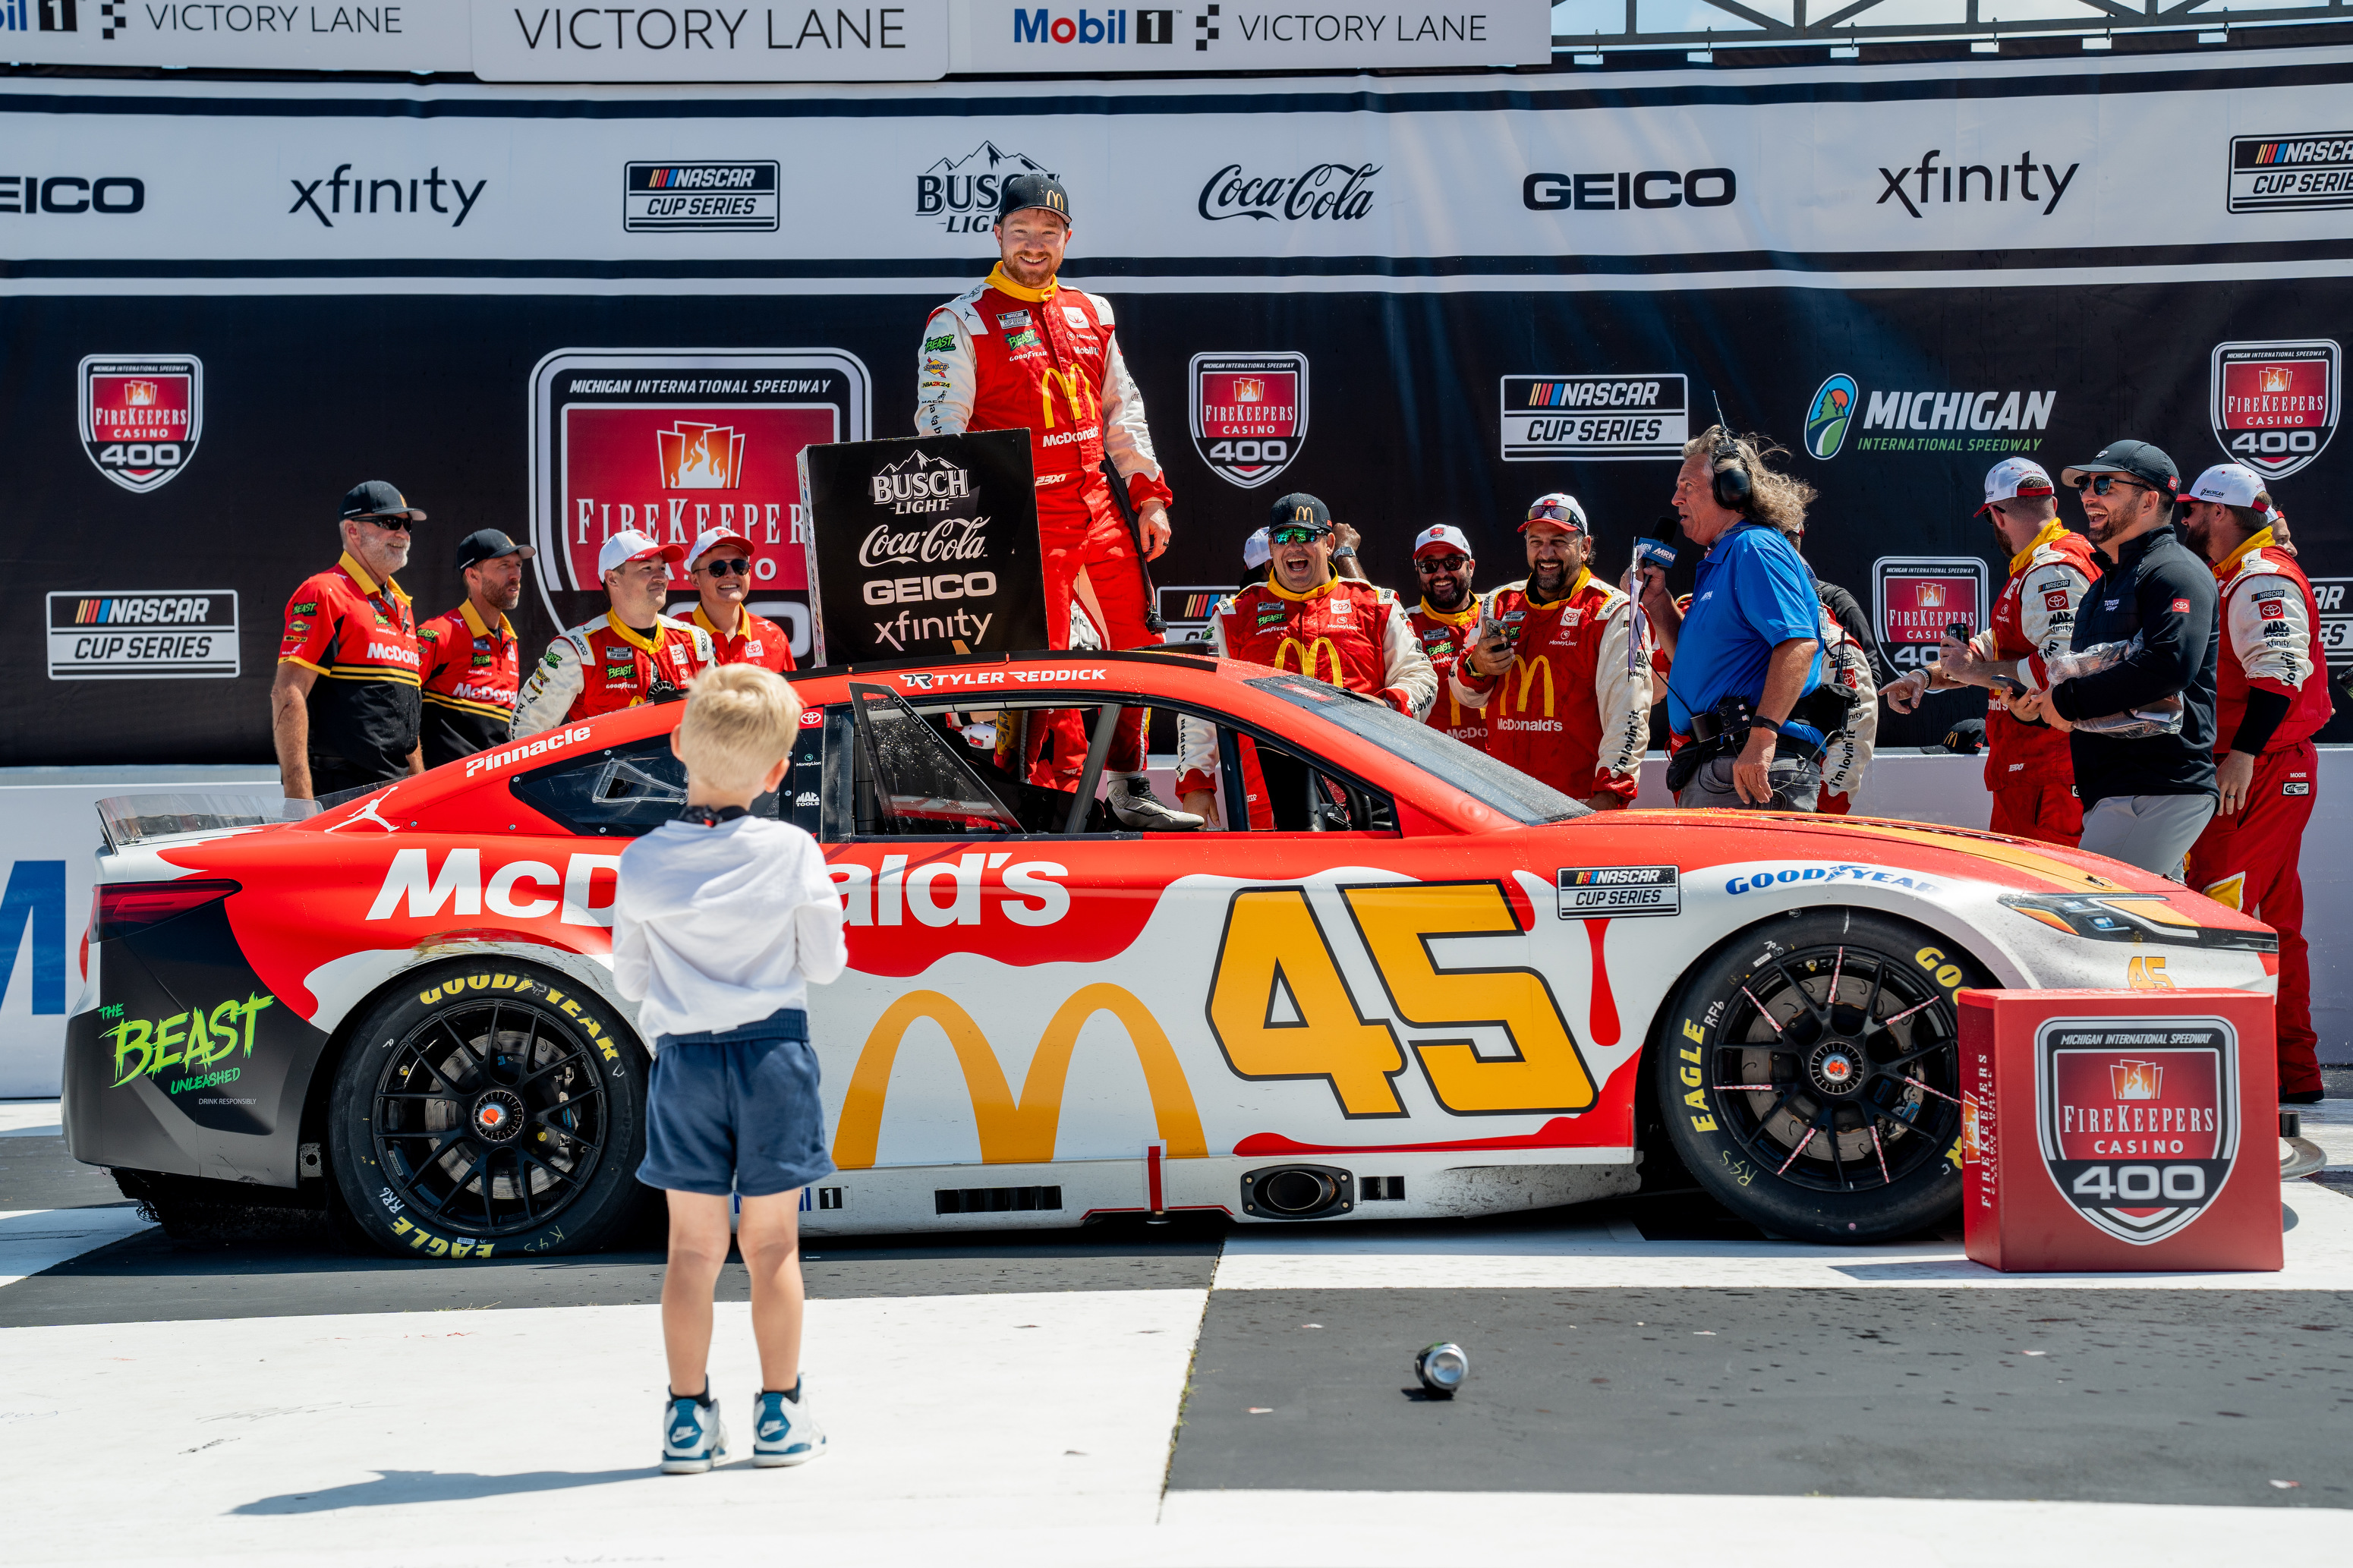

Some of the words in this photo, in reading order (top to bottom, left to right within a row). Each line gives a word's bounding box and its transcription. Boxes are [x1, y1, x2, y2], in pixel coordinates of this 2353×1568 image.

[146, 5, 298, 32] VICTORY
[311, 7, 402, 33] LANE
[514, 8, 748, 49] VICTORY
[767, 8, 906, 49] LANE
[1014, 8, 1126, 43] Mobil
[1239, 15, 1386, 41] VICTORY
[1397, 15, 1486, 41] LANE
[2284, 140, 2353, 162] NASCA
[675, 168, 756, 187] NASCAR
[1876, 150, 2080, 218] xfinity
[2253, 175, 2295, 194] CUP
[2298, 172, 2353, 193] SERIE
[0, 176, 145, 214] EICO
[289, 163, 487, 227] xfinity
[915, 173, 1061, 216] BUS
[1199, 162, 1384, 222] Coca-Cola
[1523, 168, 1736, 211] GEICO
[647, 197, 685, 215] CUP
[688, 197, 756, 215] SERIES
[945, 209, 999, 233] LIG
[1006, 311, 1024, 320] NASCAR
[925, 334, 955, 354] BEAST
[1008, 329, 1037, 351] BEAST
[1073, 346, 1093, 355] Mobil
[1010, 351, 1047, 362] GOODYEAR
[569, 379, 631, 394] MICHIGAN
[634, 379, 748, 394] INTERNATIONAL
[751, 379, 832, 394] SPEEDWAY
[1560, 382, 1660, 406] NASCAR
[1863, 390, 2057, 430] MICHIGAN
[2246, 415, 2304, 425] CASINO
[113, 429, 169, 438] CASINO
[1223, 425, 1275, 434] CASINO
[1527, 420, 1576, 442] CUP
[1578, 419, 1662, 442] SERIES
[1210, 440, 1287, 461] 400
[1857, 438, 1963, 451] INTERNATIONAL
[1967, 439, 2043, 452] SPEEDWAY
[2232, 430, 2317, 453] 400
[100, 444, 181, 465] 400
[872, 468, 969, 505] BUSCH
[576, 498, 807, 545] FIREKEEPER
[859, 516, 991, 567] Coca-Cola
[1652, 547, 1676, 562] MRN
[1804, 564, 1815, 580] MRN
[863, 571, 997, 605] GEICO
[2045, 579, 2069, 590] NASCAR
[2260, 590, 2285, 598] NASCAR
[108, 598, 210, 623] NASCAR
[1257, 612, 1286, 628] BEAST
[874, 608, 993, 651] xfinity
[1906, 631, 1947, 639] CASIN
[2263, 621, 2290, 633] MAC
[74, 637, 124, 659] CUP
[127, 636, 212, 658] SERIES
[367, 643, 419, 666] McDona
[1428, 641, 1453, 658] BEAST
[2266, 639, 2291, 648] xfinity
[1432, 656, 1460, 665] OODYEAR
[1895, 646, 1941, 666] 40
[607, 664, 635, 679] BEAST
[934, 672, 1006, 685] TYLER
[1007, 669, 1107, 682] REDDICK
[452, 682, 518, 704] McDona
[1497, 718, 1564, 732] McDonald's
[466, 726, 591, 778] Pinnacle
[1829, 770, 1845, 788] i'm
[1838, 740, 1854, 770] lovin'
[1846, 730, 1856, 738] it
[795, 792, 821, 803] MAC
[365, 848, 1071, 927] McDald's
[1594, 869, 1661, 884] NASCAR
[1725, 864, 1945, 896] GOODYEAR
[1575, 891, 1606, 906] CUP
[1608, 889, 1662, 905] SERIES
[2128, 956, 2175, 988] 45
[1205, 879, 1599, 1120] 45
[98, 1003, 124, 1020] THE
[99, 991, 275, 1088] BEAST
[2061, 1033, 2103, 1045] MICHIGAN
[2105, 1033, 2168, 1045] INTERNATIONAL
[2170, 1033, 2213, 1045] SPEEDWAY
[170, 1067, 241, 1095] UNLEASHED
[1680, 1019, 1719, 1133] EAGLE
[2093, 1139, 2184, 1154] CASINO
[2073, 1165, 2206, 1200] 400
[389, 1215, 496, 1259] EAGLE
